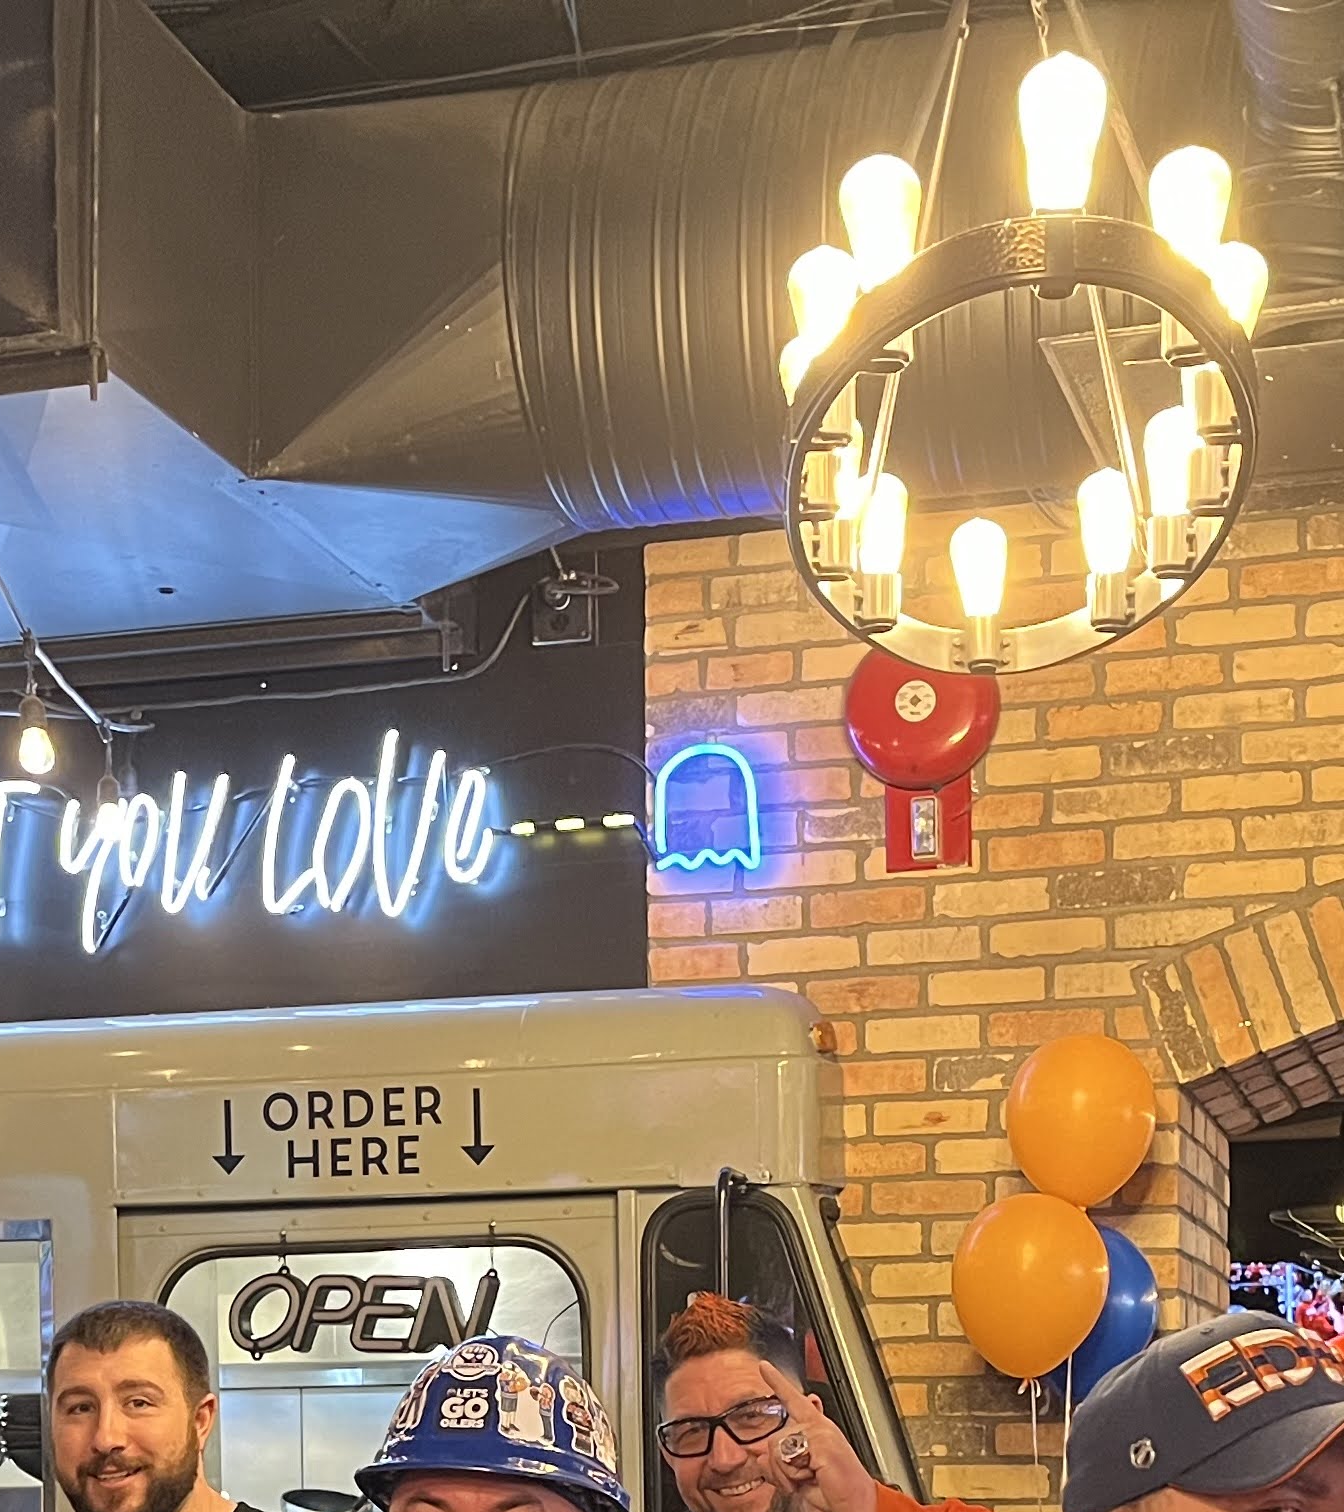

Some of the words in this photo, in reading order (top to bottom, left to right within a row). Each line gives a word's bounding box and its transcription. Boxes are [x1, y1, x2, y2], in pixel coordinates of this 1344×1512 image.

[262, 1085, 443, 1133] ORDER
[287, 1135, 420, 1179] HERE
[229, 1272, 500, 1354] OPEN
[440, 1396, 490, 1419] GO
